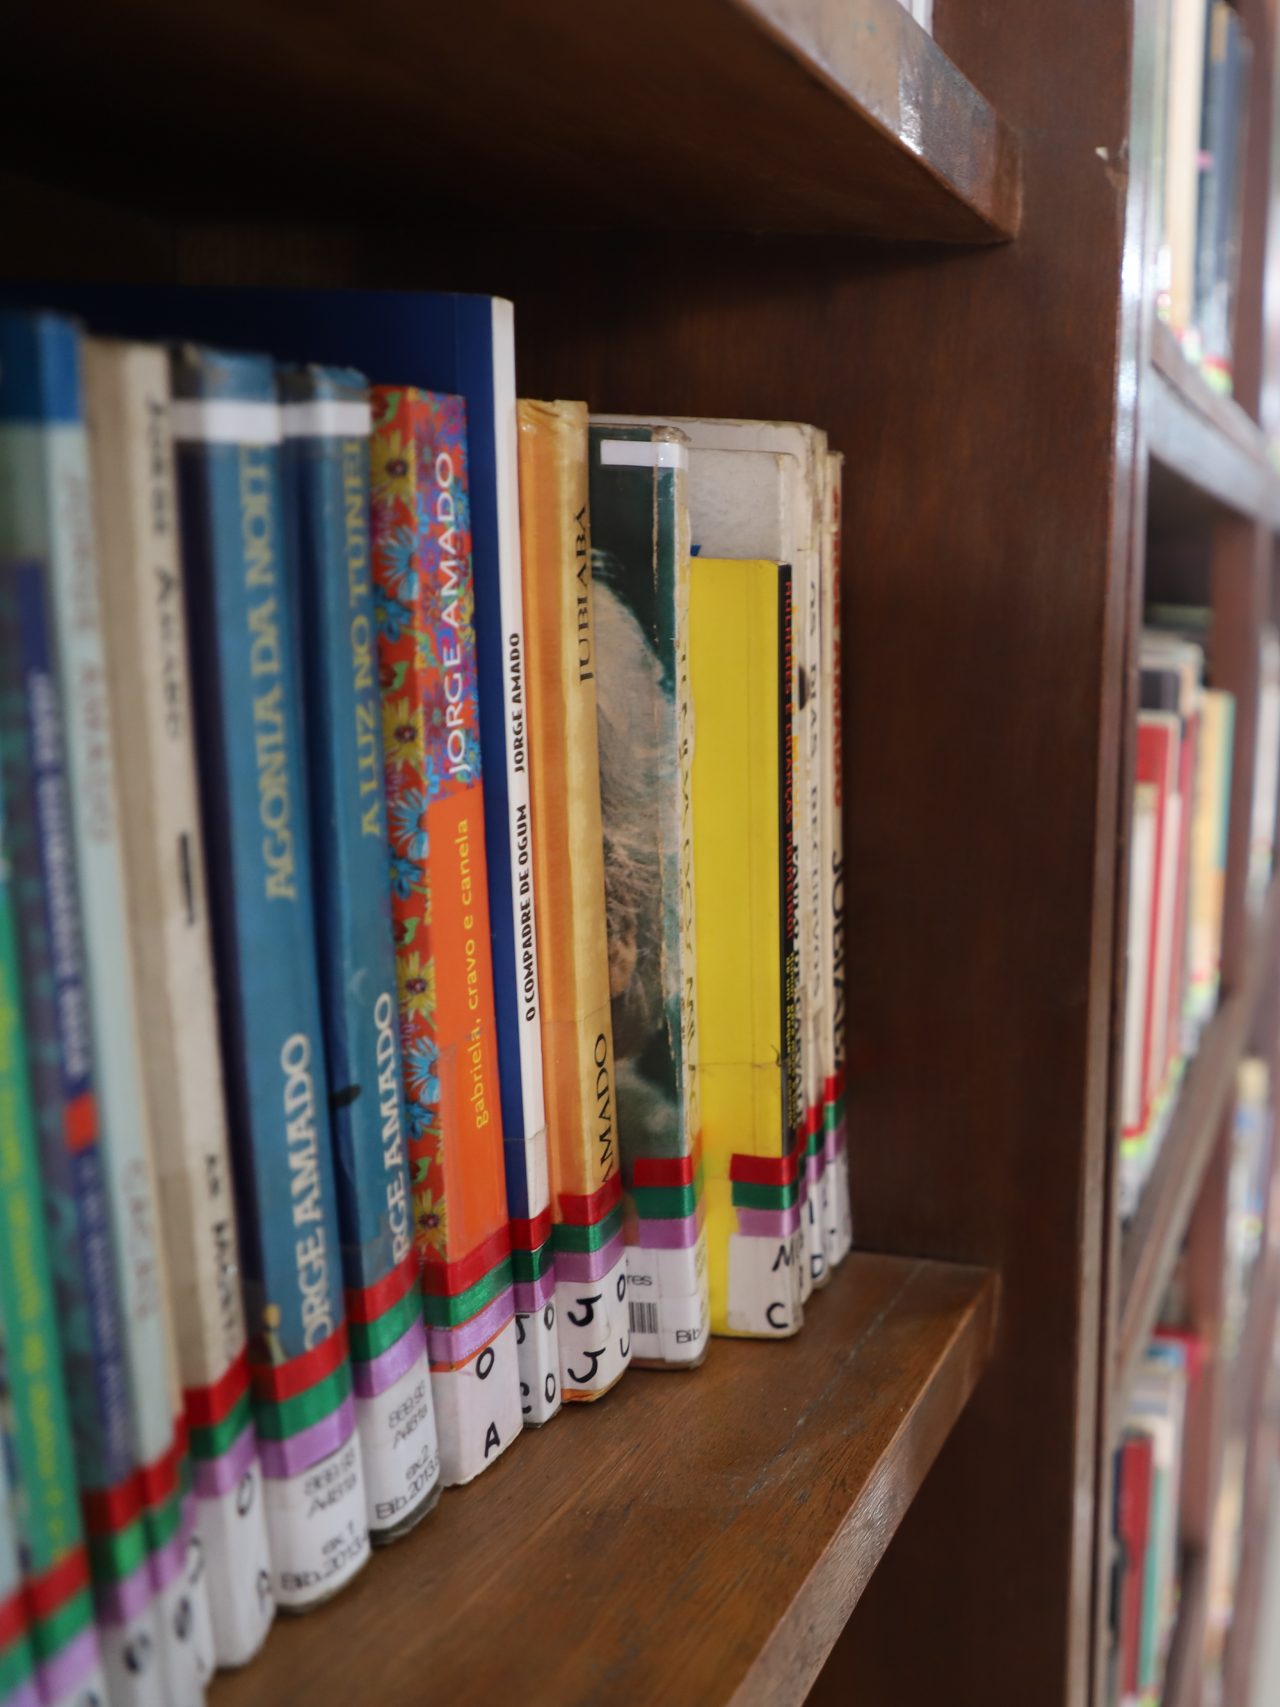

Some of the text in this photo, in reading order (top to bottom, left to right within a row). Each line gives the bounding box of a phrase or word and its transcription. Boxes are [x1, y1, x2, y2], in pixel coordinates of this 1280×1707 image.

[239, 442, 297, 901] AGONIA DA NOIT
[350, 614, 373, 692] NO
[436, 453, 470, 774] JORGE AMADO
[509, 633, 526, 773] JORGE AMADO
[355, 700, 378, 797] LUZ
[361, 804, 381, 837] A
[455, 818, 489, 1130] gabriela, cravo e canela
[515, 804, 536, 1023] O COMPADRE DE OGUM
[280, 1033, 335, 1350] ORGE AMADO
[373, 993, 408, 1265] RGE AMADO
